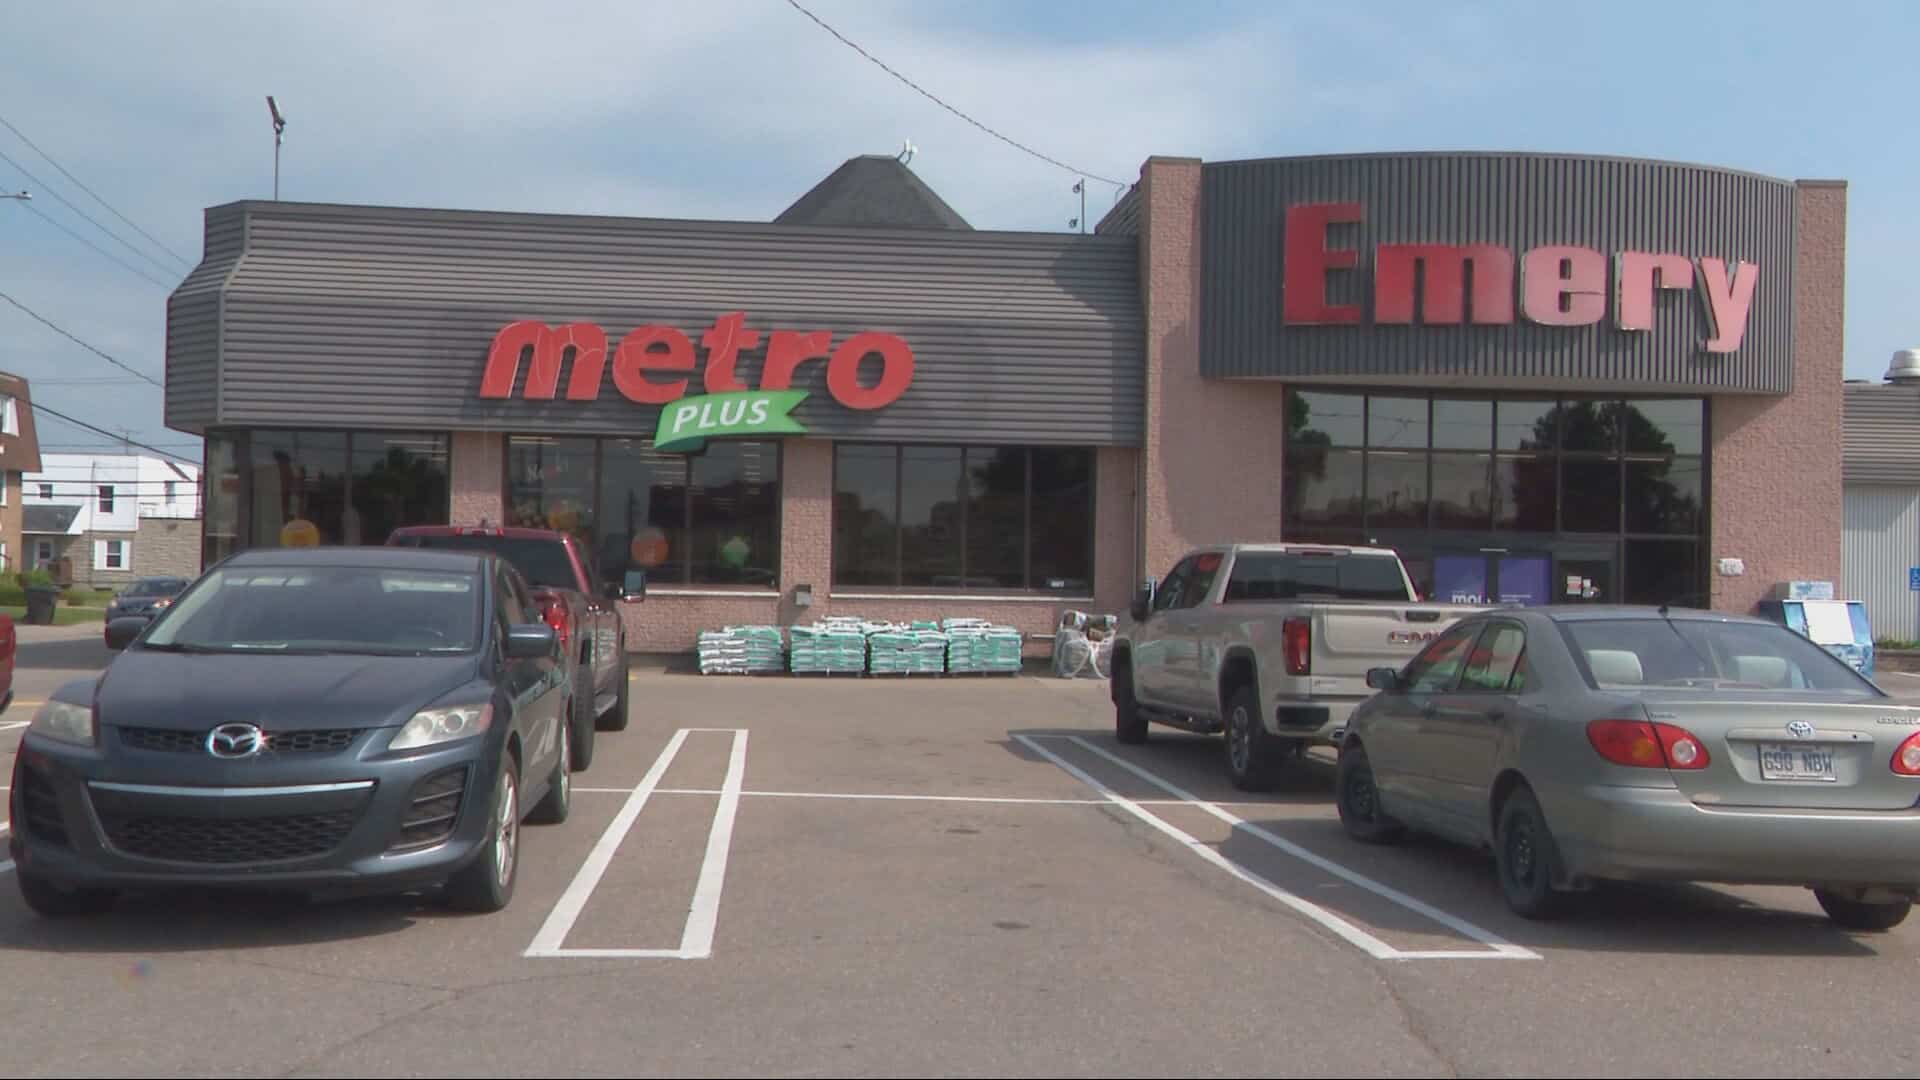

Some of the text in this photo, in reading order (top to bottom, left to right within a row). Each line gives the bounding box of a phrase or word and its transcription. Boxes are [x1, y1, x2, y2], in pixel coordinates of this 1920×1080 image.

[1283, 203, 1759, 354] Emery
[480, 312, 916, 410] metro
[672, 399, 770, 434] PLUS
